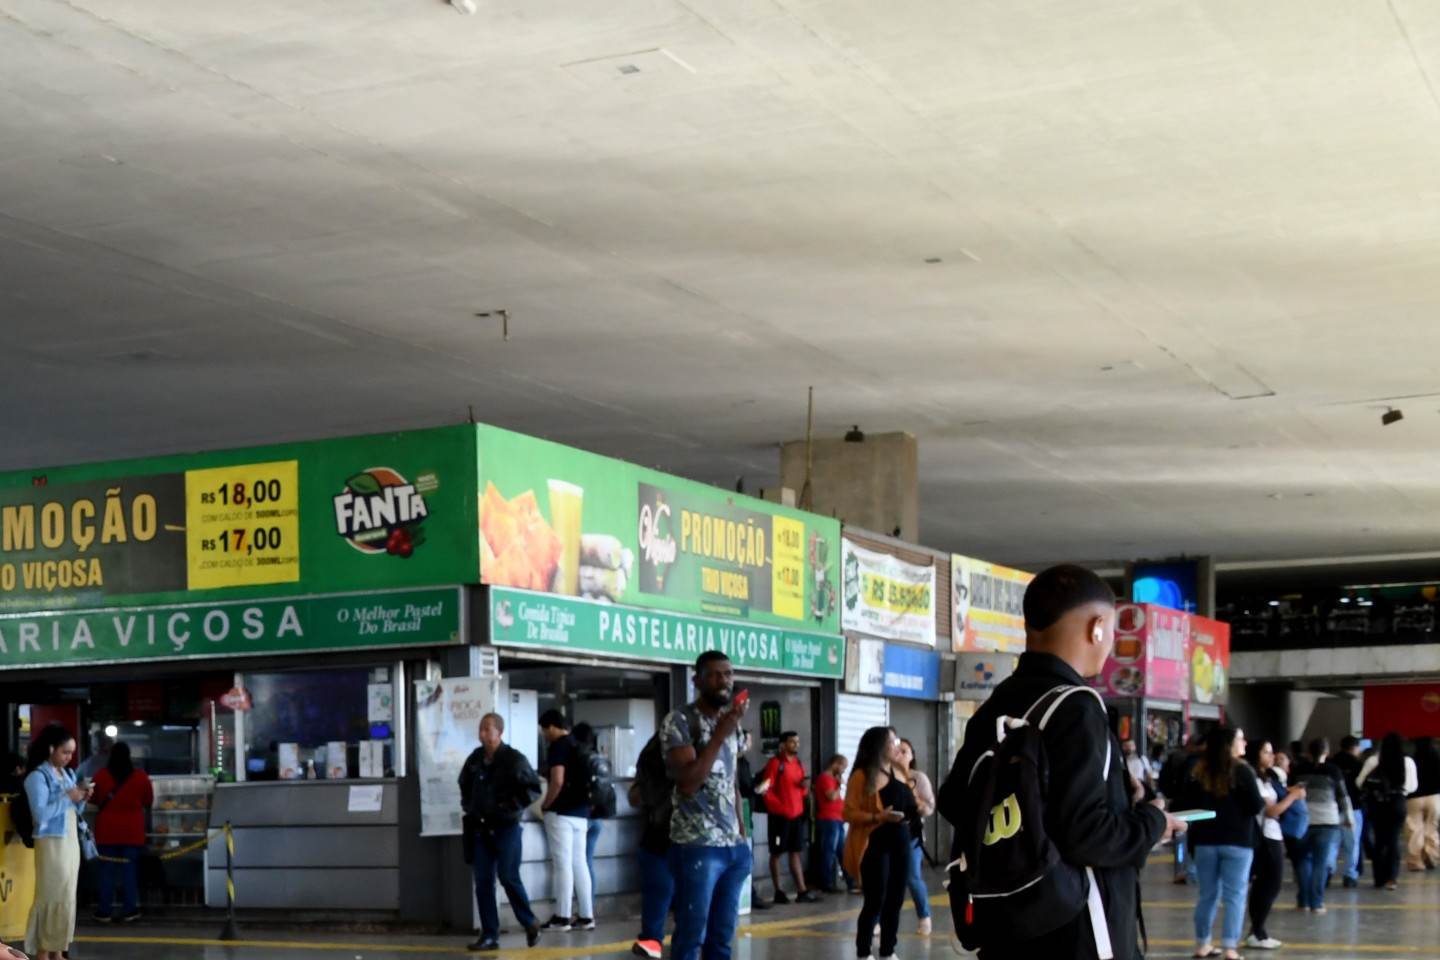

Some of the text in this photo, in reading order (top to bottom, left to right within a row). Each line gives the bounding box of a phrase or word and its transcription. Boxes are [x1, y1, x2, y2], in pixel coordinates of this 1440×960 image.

[218, 478, 281, 510] 18,00
[334, 485, 428, 534] FANTA
[219, 526, 281, 556] 17,00
[681, 509, 765, 568] PROMOÇÃO
[22, 558, 104, 592] VIÇOSA
[353, 605, 400, 622] Melhor
[404, 601, 443, 618] Pastel
[383, 618, 421, 633] Brasil
[113, 606, 303, 652] VIÇOSA
[599, 610, 779, 664] PASTELARIA VIÇOSA
